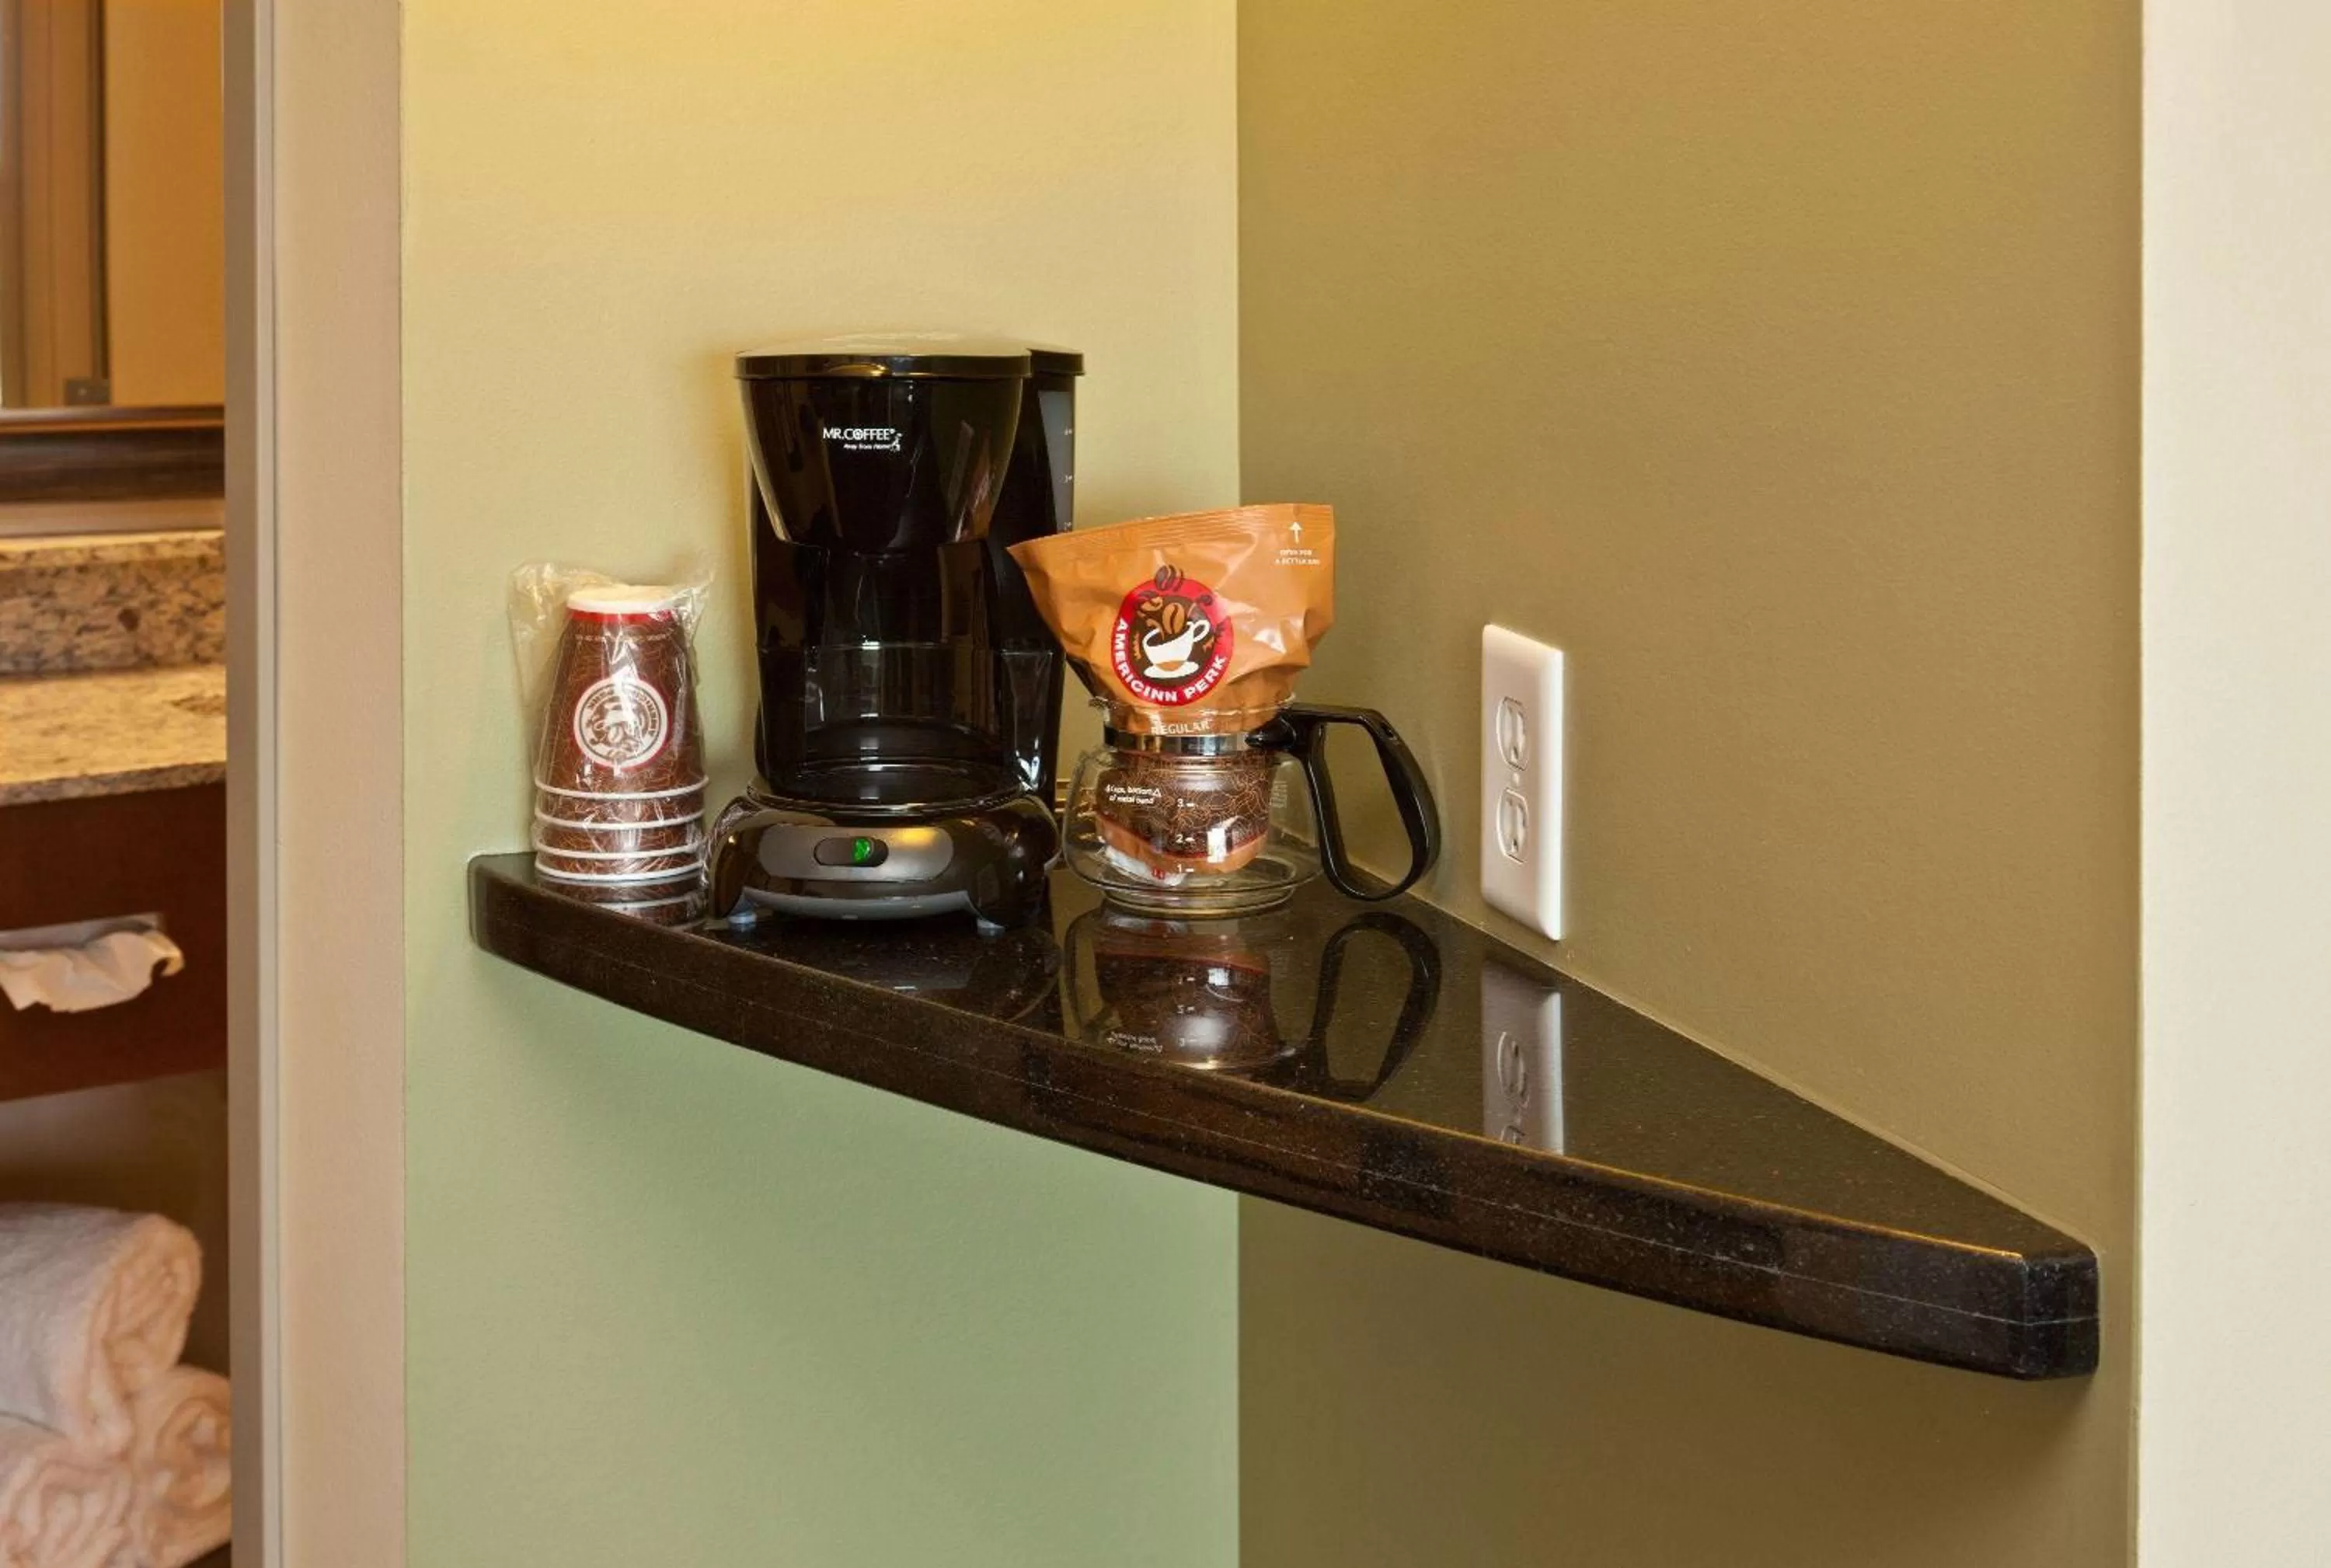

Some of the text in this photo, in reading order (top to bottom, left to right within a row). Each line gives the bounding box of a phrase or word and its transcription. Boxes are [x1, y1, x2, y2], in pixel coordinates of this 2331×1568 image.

[1113, 618, 1228, 702] AMERICINN PERK
[1150, 717, 1211, 735] REGULAR
[1176, 798, 1183, 807] 3
[1175, 834, 1183, 844] 2
